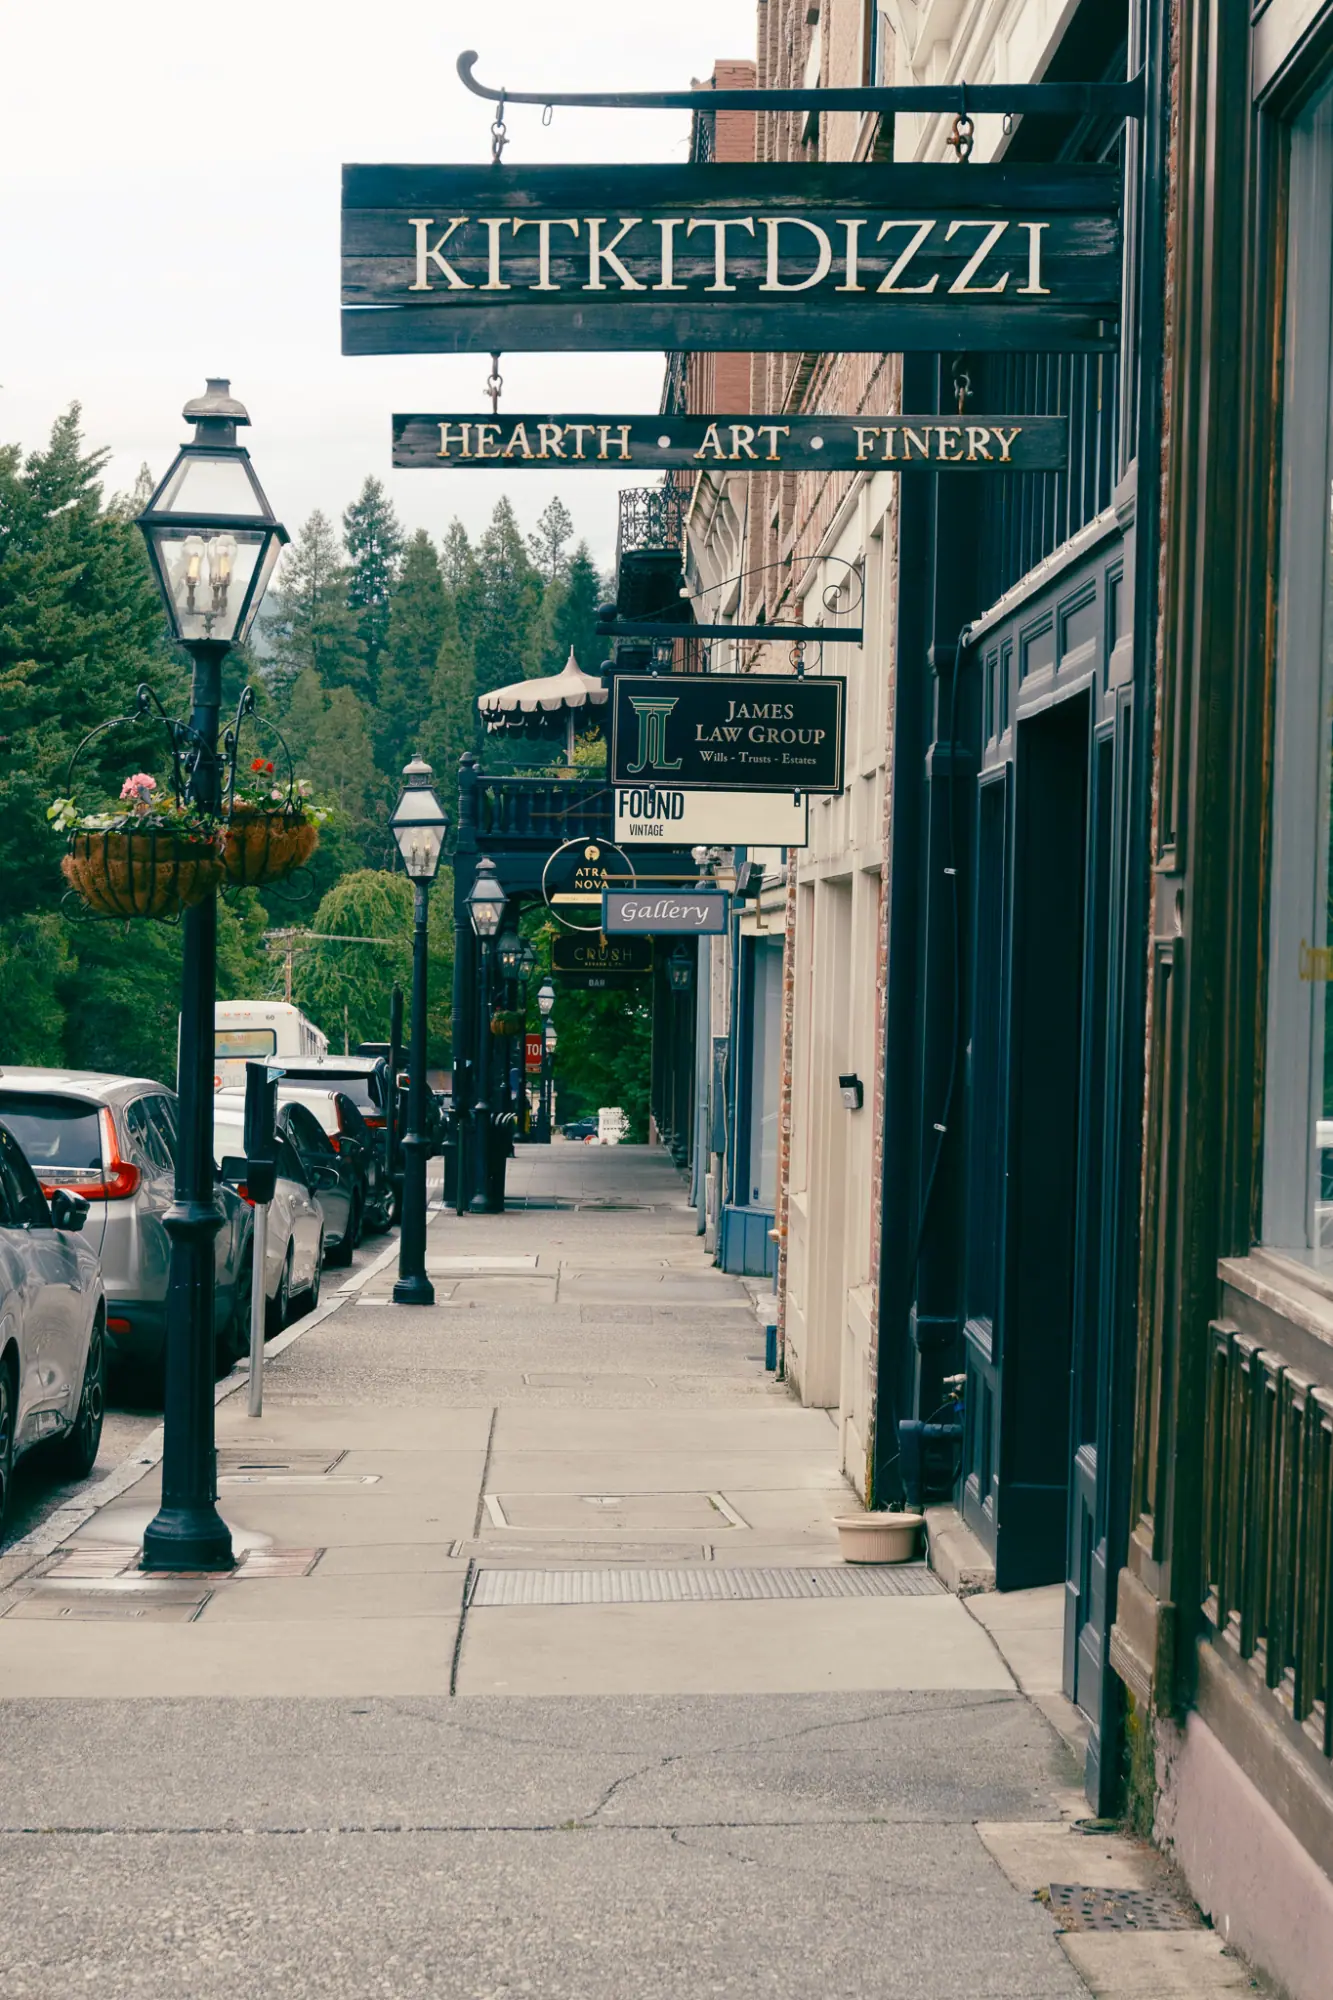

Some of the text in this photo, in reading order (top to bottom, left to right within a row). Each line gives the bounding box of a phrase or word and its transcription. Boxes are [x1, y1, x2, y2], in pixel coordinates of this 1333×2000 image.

[408, 215, 1051, 295] KITKITDIZZI
[436, 421, 1022, 463] HEARTH ART FINERY
[747, 726, 827, 746] GROUP
[698, 750, 729, 763] Wills
[738, 751, 772, 765] Trusts
[781, 752, 818, 766] Estates
[618, 789, 685, 821] FOUND
[628, 822, 665, 838] VINTAGE
[575, 867, 609, 878] ATRA
[574, 880, 610, 890] NOVA
[620, 900, 710, 924] Gallery
[573, 946, 634, 962] CRUSH
